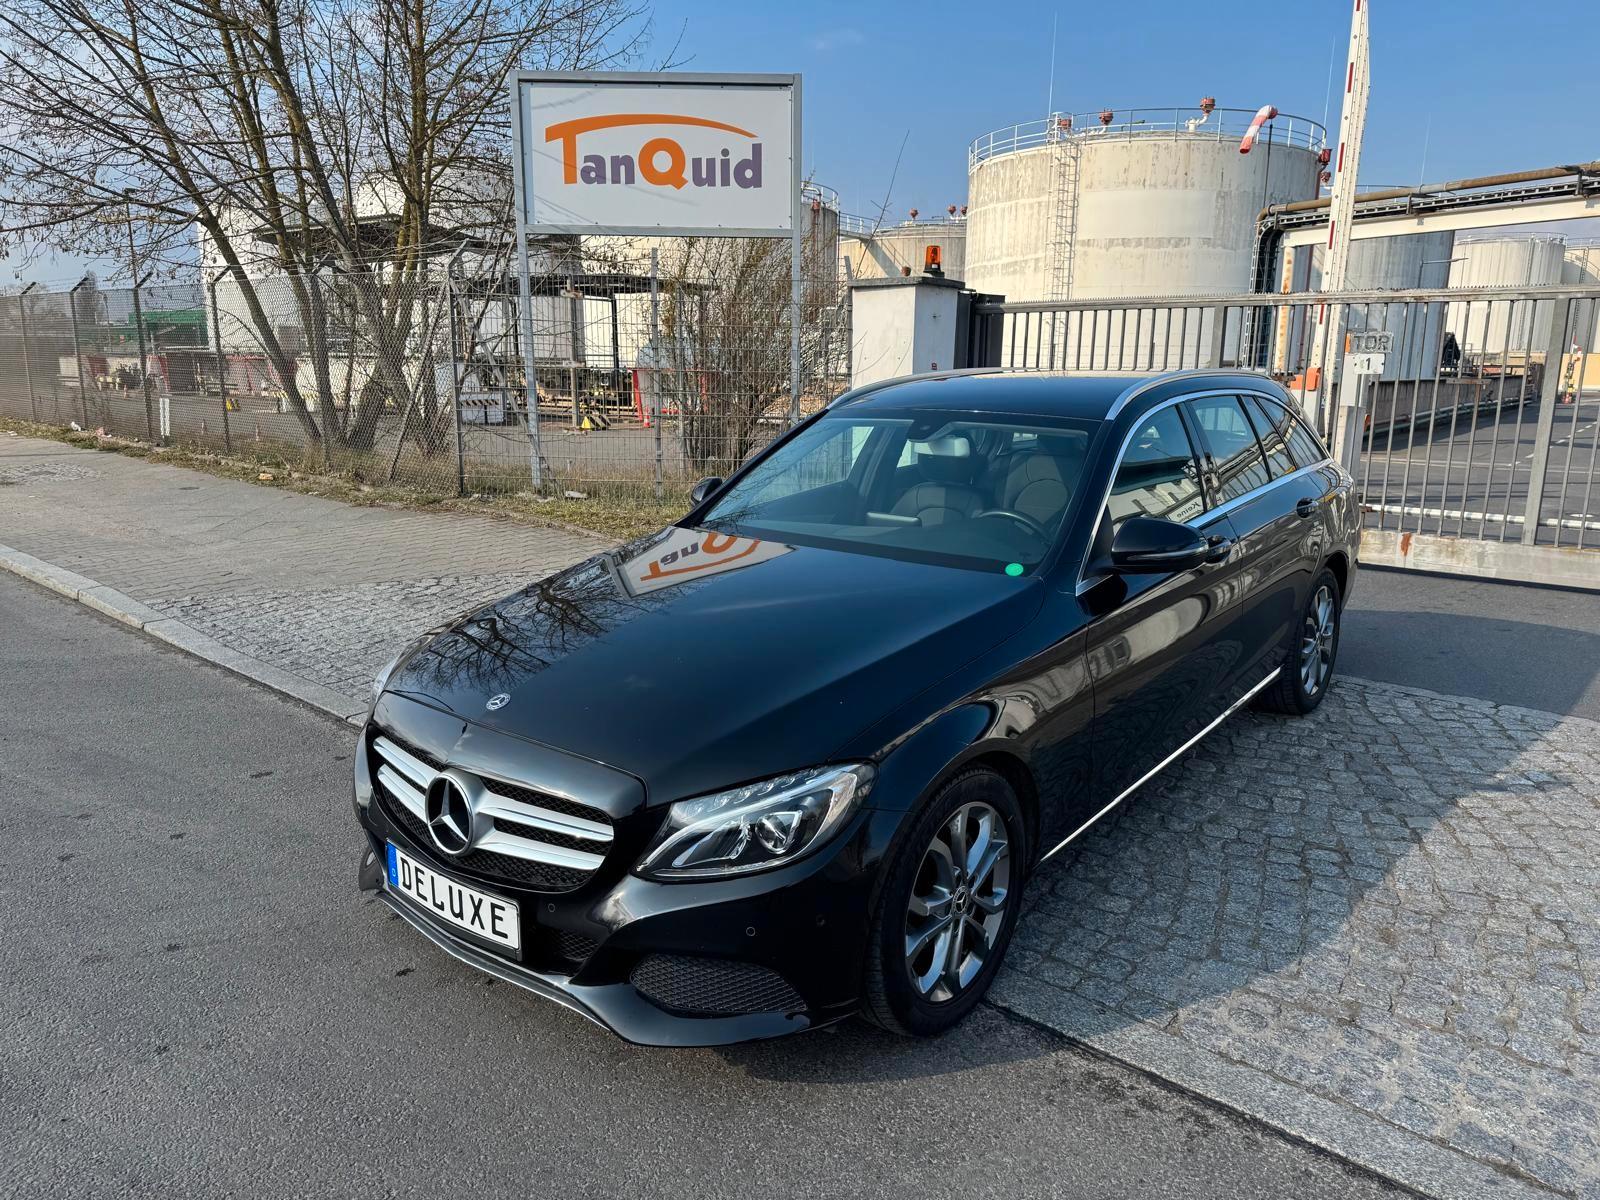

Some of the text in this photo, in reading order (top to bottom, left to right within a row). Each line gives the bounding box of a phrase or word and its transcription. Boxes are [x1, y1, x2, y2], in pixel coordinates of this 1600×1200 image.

[545, 113, 763, 191] TanQuid
[1353, 334, 1390, 352] TOR
[1365, 356, 1371, 371] 1
[400, 856, 509, 939] DELUXE
